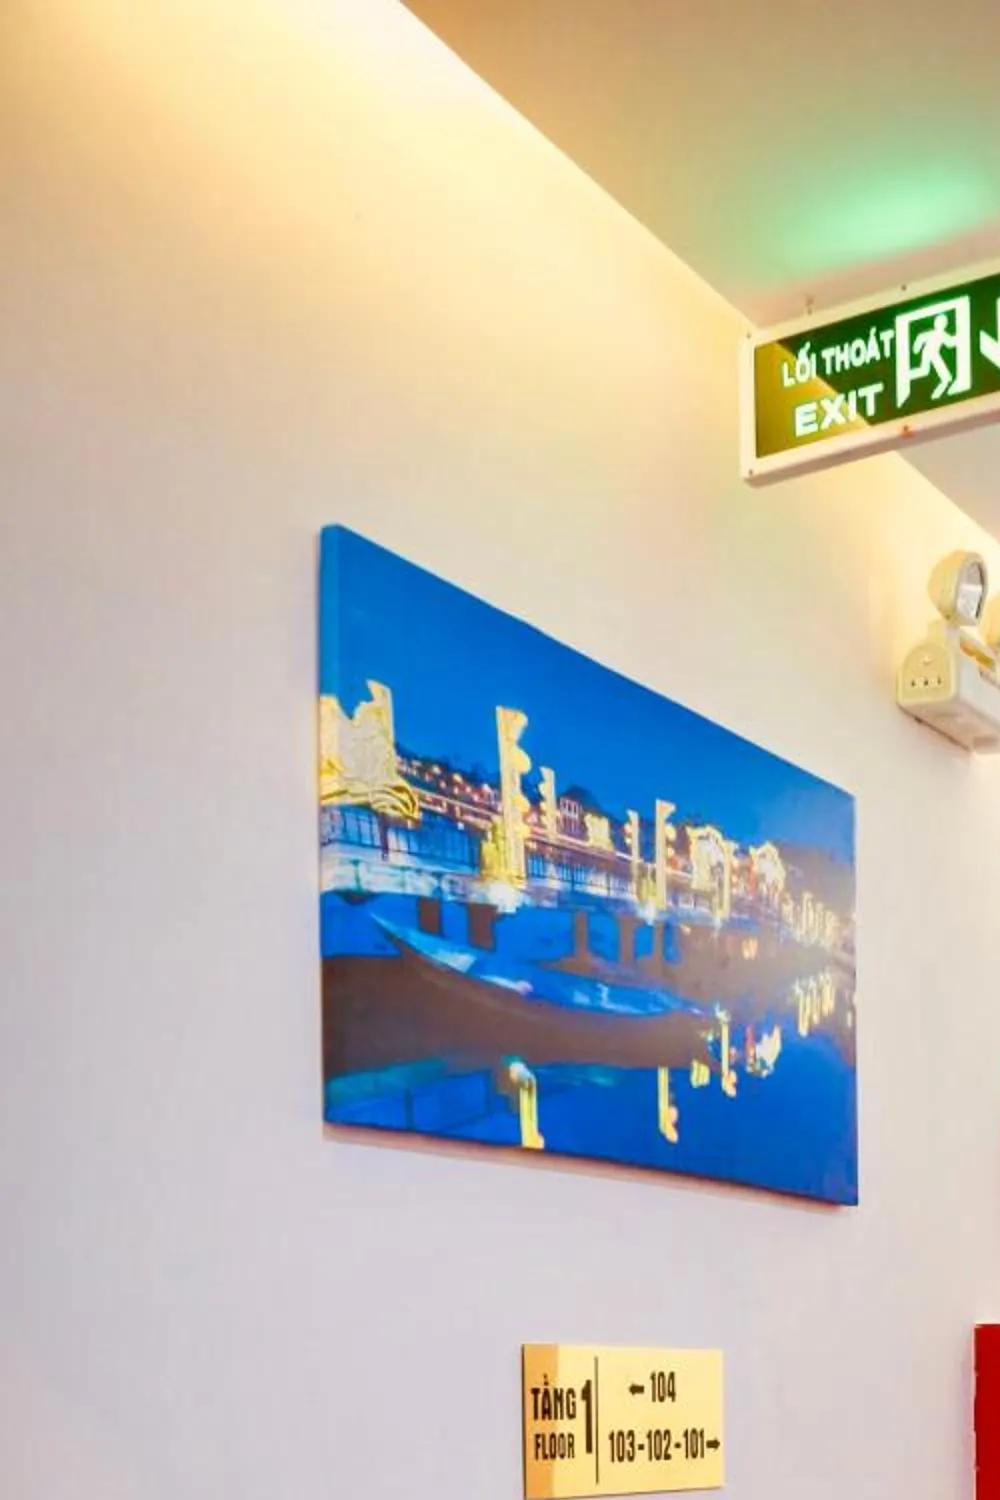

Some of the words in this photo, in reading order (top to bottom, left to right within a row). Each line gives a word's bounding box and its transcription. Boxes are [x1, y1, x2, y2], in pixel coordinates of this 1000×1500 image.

[821, 327, 894, 375] THOÁT
[795, 382, 884, 437] EXIT
[650, 1371, 676, 1402] 104
[581, 1379, 592, 1454] 1
[534, 1432, 575, 1460] FLOOR
